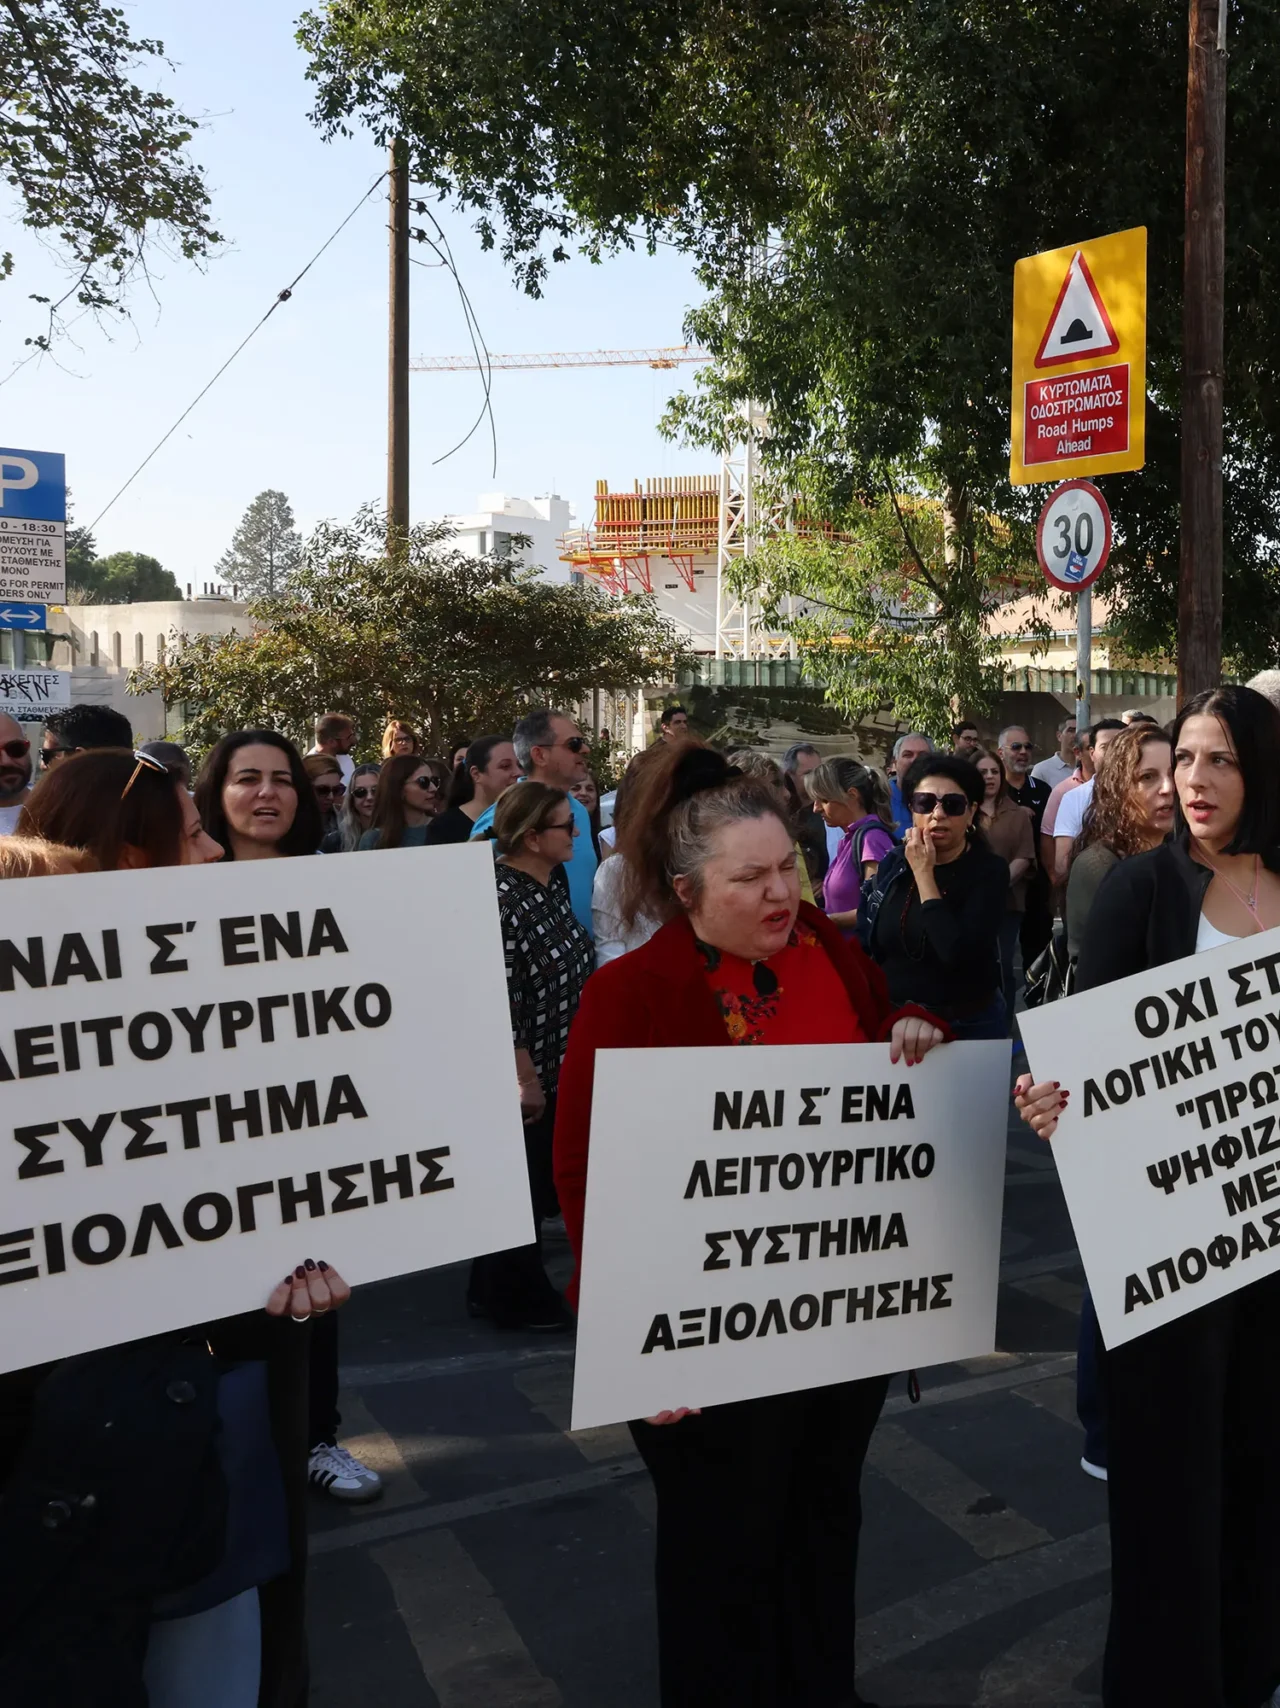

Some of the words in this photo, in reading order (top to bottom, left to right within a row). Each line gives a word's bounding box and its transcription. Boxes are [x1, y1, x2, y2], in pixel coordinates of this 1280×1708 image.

[1040, 374, 1112, 401] ΚΥΡΤΩΜΑΤΑ
[1030, 390, 1123, 420] ΟΔΟΣΤΡΩΜΑΤΟΣ
[1037, 420, 1067, 439] Road
[1072, 416, 1113, 432] Humps
[1056, 436, 1091, 454] Ahead
[0, 455, 39, 508] P
[0, 536, 34, 546] ΜΕΥΣΗ
[36, 539, 51, 547] ΓΙΑ
[21, 523, 56, 533] 18:30
[1053, 512, 1093, 558] 30
[1, 556, 62, 568] ΣΤΑΘΜΕΥΣΗΣ
[40, 549, 53, 557] ΜΕ
[1, 566, 30, 575] ΜΟΝΟ
[9, 580, 29, 588] FOR
[31, 581, 64, 590] PERMIT
[27, 590, 51, 599] ONLY
[0, 929, 122, 992] ΝΑΙ
[219, 907, 349, 967] ΕΝΑ
[1134, 976, 1219, 1040] ΟΧΙ
[1082, 1035, 1217, 1118] ΛΟΓΙΚΗ
[713, 1089, 784, 1131] ΝΑΙ
[841, 1083, 915, 1124] ΕΝΑ
[13, 1074, 369, 1180] ΣΥΣΤΗΜΑ
[683, 1142, 936, 1200] ΛΕΙΤΟΥΡΓΙΚΟ
[703, 1212, 909, 1272] ΣΥΣΤΗΜΑ
[641, 1273, 954, 1355] ΑΞΙΟΛΟΓΗΣΗΣ
